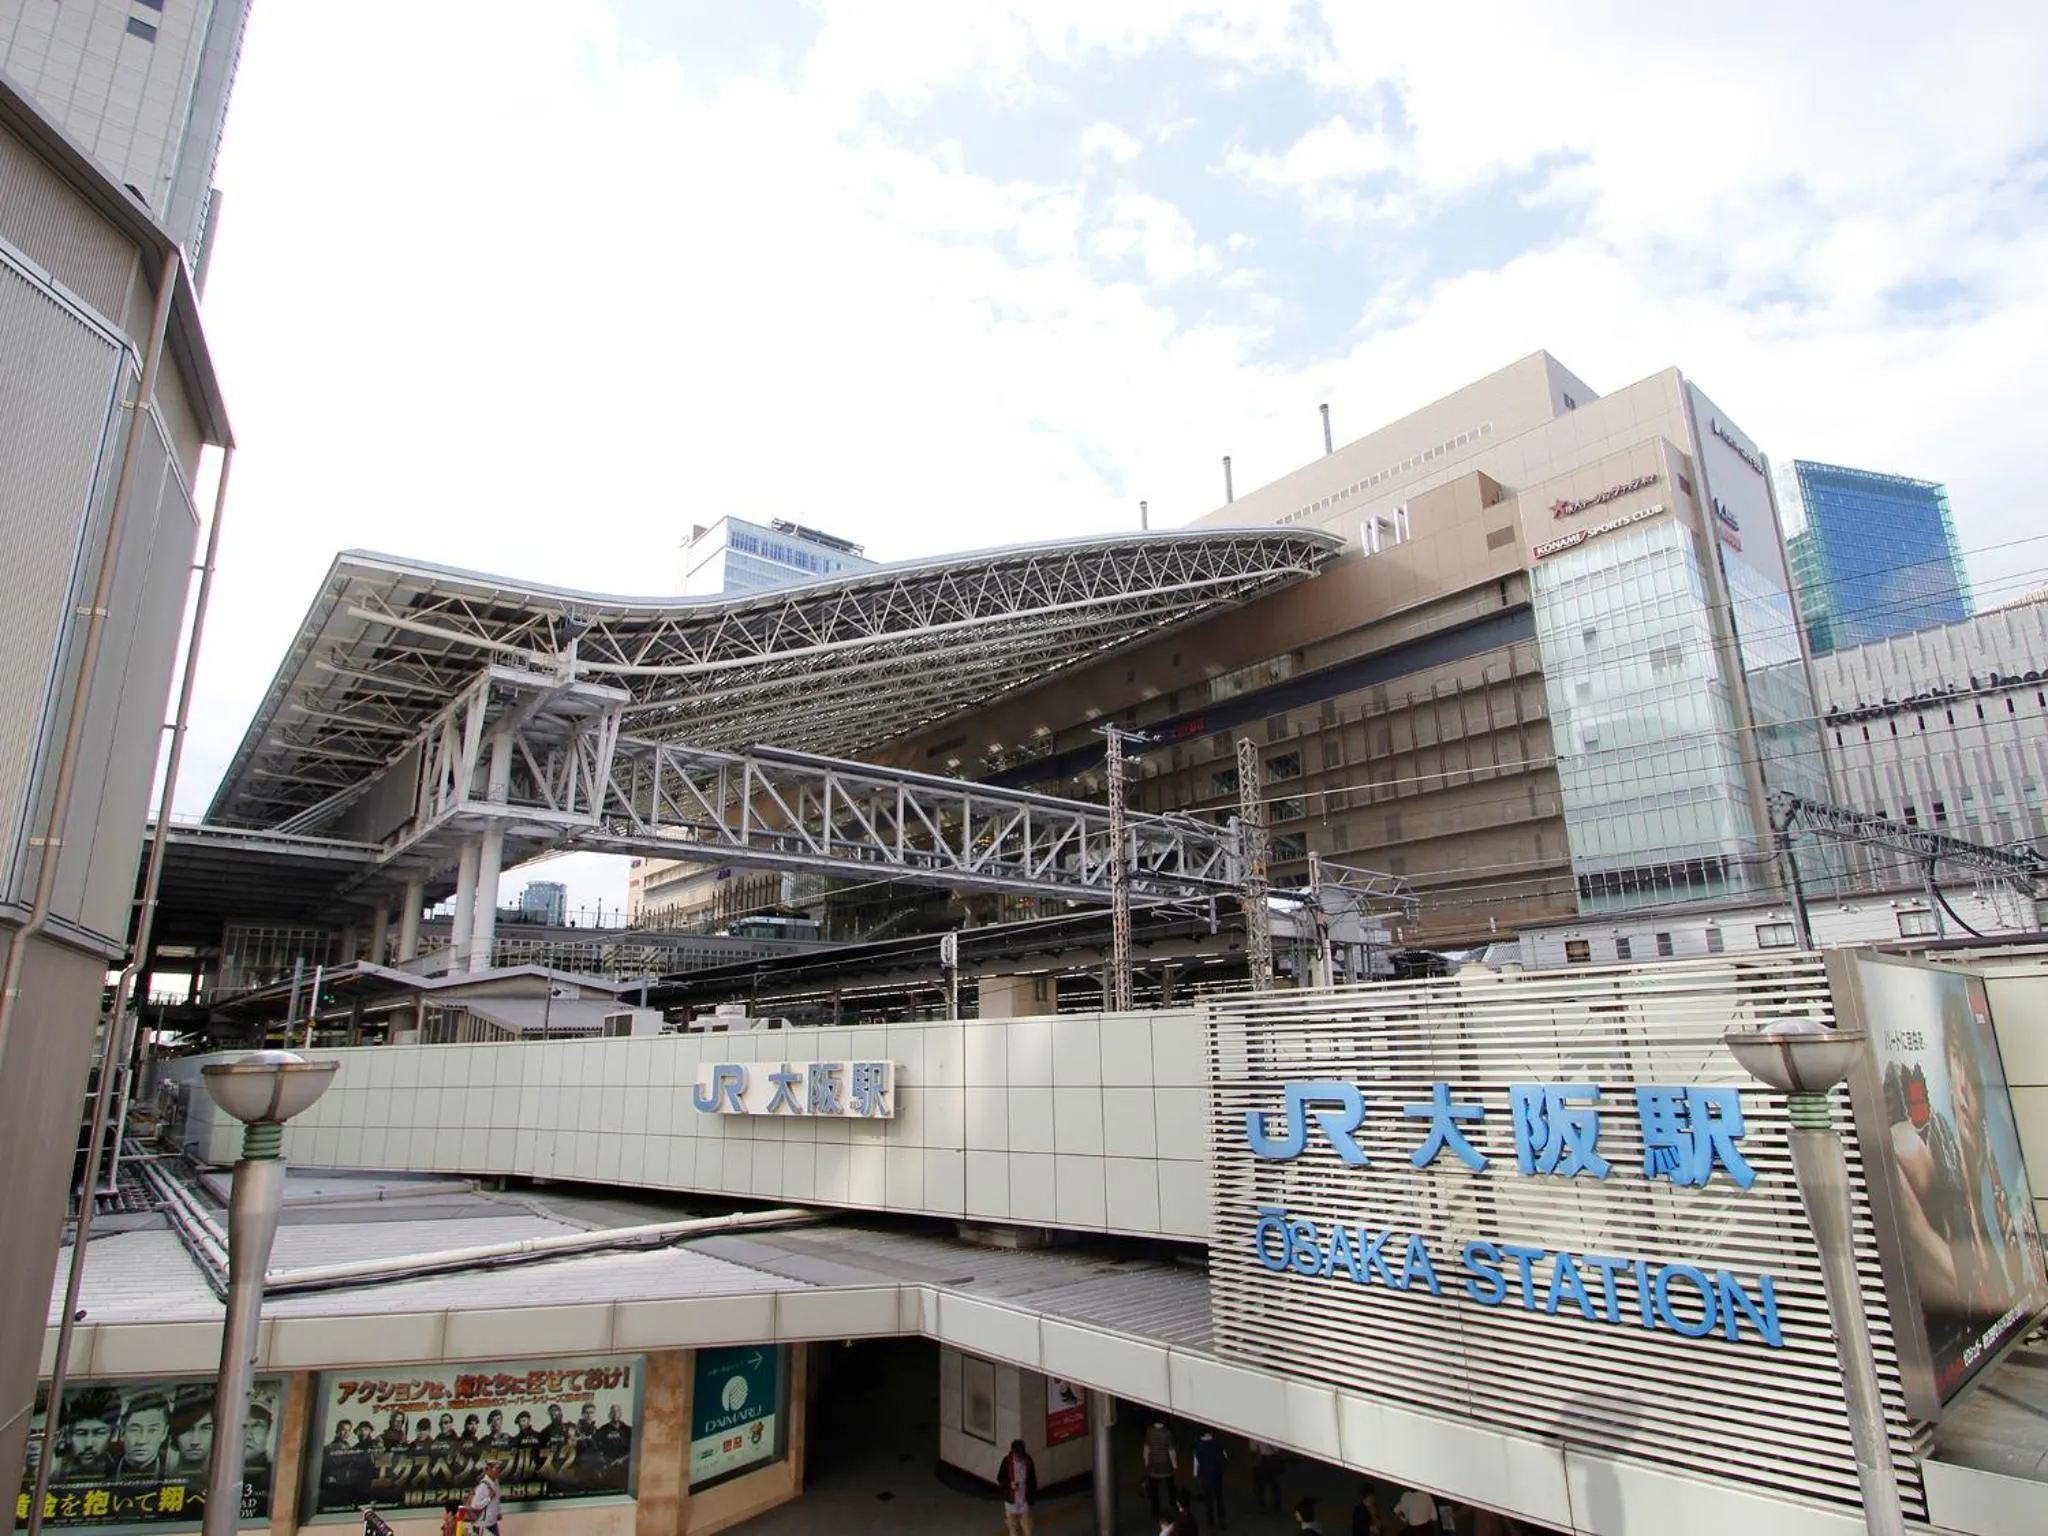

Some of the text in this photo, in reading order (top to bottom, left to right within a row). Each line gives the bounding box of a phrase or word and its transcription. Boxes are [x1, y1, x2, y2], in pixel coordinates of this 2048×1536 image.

[1536, 504, 1664, 555] KONAMI SPORTS CLUB
[1463, 1239, 1785, 1348] STATION
[704, 1404, 763, 1433] DAIMARU
